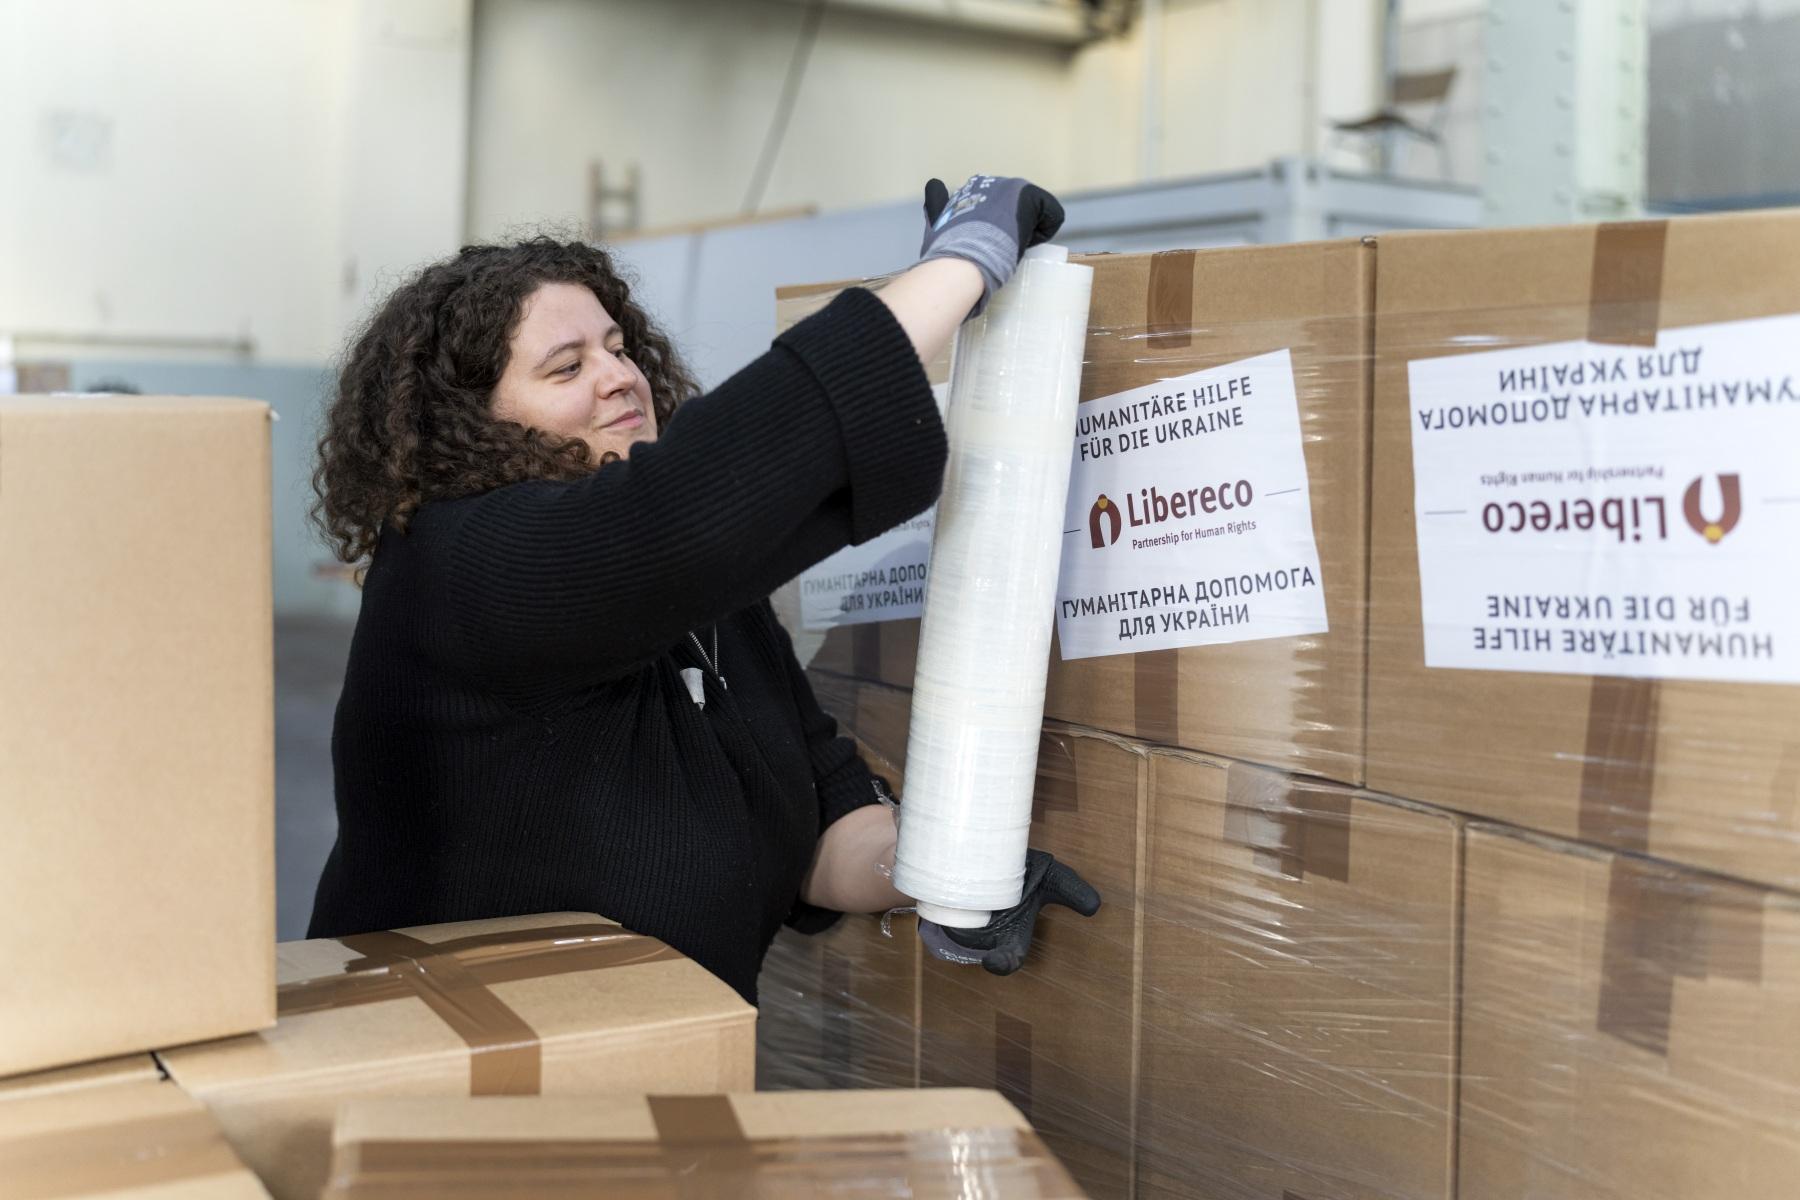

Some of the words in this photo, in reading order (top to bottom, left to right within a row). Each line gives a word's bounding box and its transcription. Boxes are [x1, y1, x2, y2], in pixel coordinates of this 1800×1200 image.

[1499, 358, 1627, 393] УКРАЇНИ
[1637, 347, 1702, 376] ДЛЯ
[1193, 376, 1252, 409] HILFE
[1419, 394, 1570, 431] ДОПОМОГА
[1080, 436, 1114, 462] FÜR
[1119, 427, 1150, 453] DIE
[1155, 407, 1244, 444] UKRAINE
[1480, 473, 1518, 486] Rights
[1521, 469, 1563, 484] Human
[1126, 479, 1253, 527] Libereco
[1482, 496, 1667, 543] Libereco
[1132, 533, 1179, 550] Partnership
[1181, 530, 1193, 542] for
[1195, 525, 1225, 539] Human
[1227, 520, 1257, 535] Rights
[889, 563, 926, 584] ДОПО
[840, 594, 864, 612] ДЛЯ
[867, 588, 923, 608] УКРАЇНИ
[1062, 584, 1190, 619] ГУМАНІТАРНА
[1195, 566, 1315, 605] ДОПОМОГА
[1118, 615, 1155, 640] ДЛЯ
[1161, 603, 1250, 632] УКРАЇНИ
[1488, 596, 1612, 620] UKRAINE
[1625, 596, 1675, 621] DIE
[1690, 597, 1751, 627] FÜR
[1474, 627, 1551, 652] HILFE
[1562, 628, 1774, 660] HUMANITÄRE
